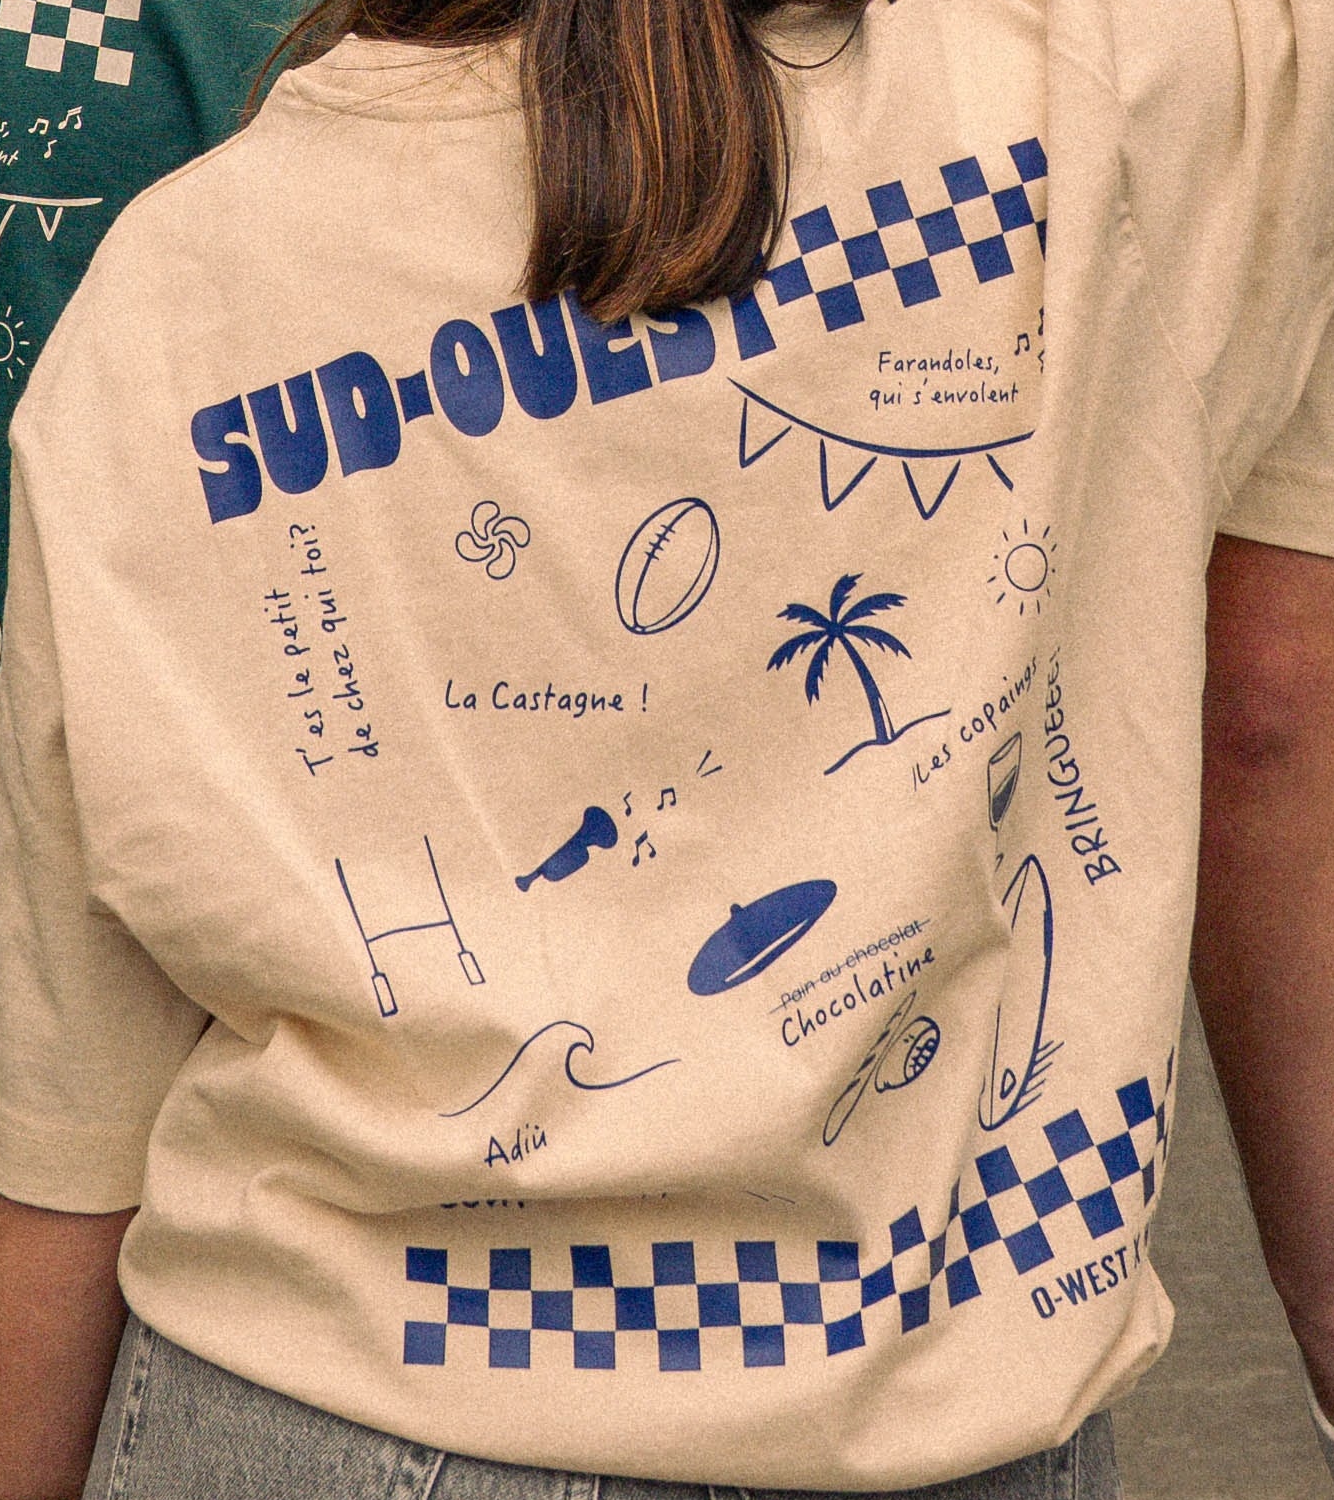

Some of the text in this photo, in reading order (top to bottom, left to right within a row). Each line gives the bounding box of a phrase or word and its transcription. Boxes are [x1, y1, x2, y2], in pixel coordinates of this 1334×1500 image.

[869, 377, 1019, 411] qui s'envolent
[877, 348, 999, 375] Farandoles,
[289, 523, 380, 758] de chez qui toi?
[264, 588, 334, 776] T'es le petit
[445, 679, 478, 710] La
[491, 680, 624, 718] Castagne
[959, 655, 1037, 743] copaings
[782, 947, 935, 1047] Chocolatine
[1031, 1245, 1129, 1320] O-WEST
